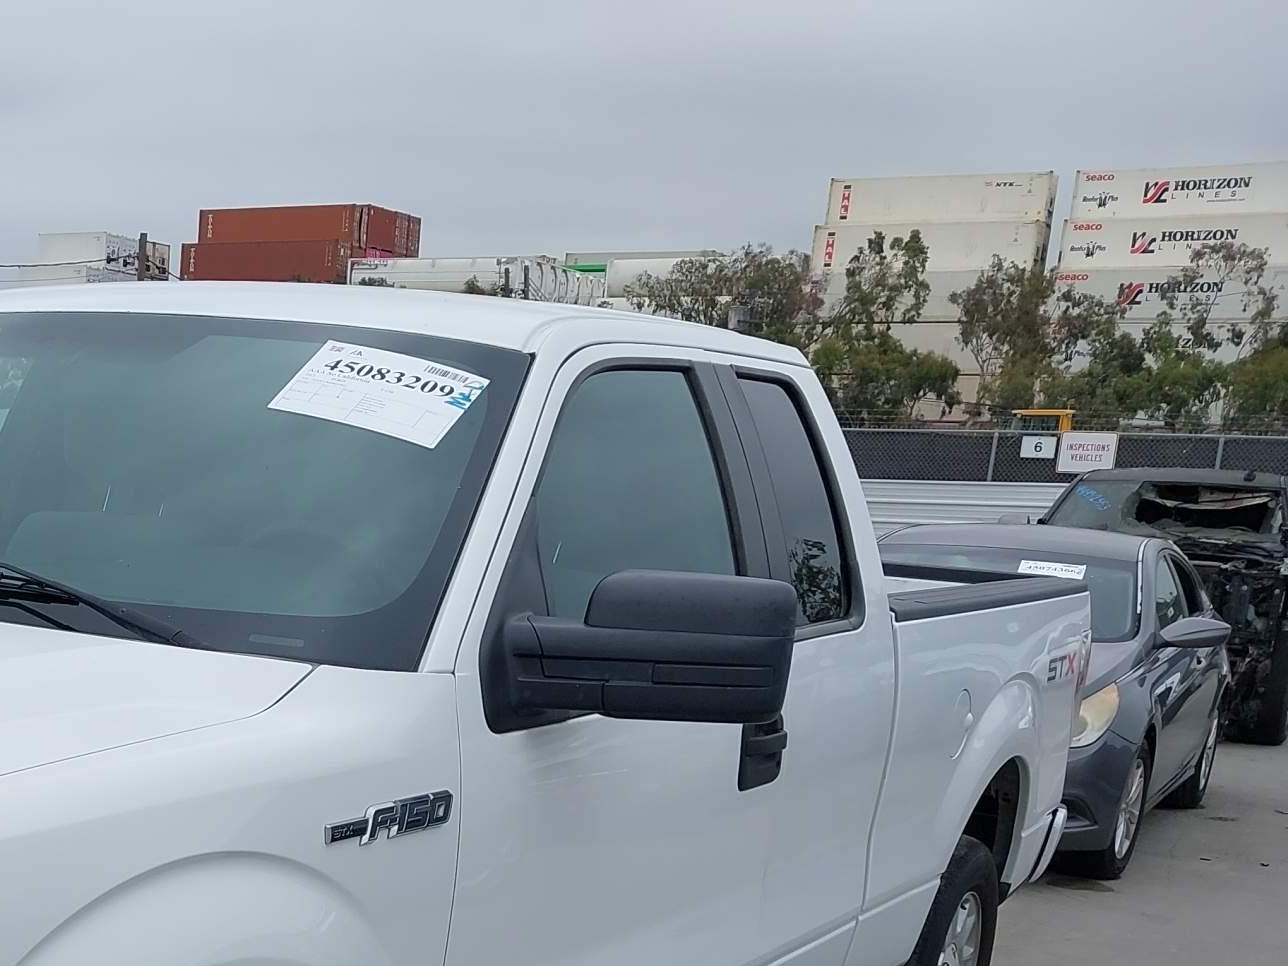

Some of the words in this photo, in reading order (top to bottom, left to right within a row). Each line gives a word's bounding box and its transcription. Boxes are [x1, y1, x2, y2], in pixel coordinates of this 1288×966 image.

[1085, 174, 1115, 182] seaco
[1172, 177, 1253, 192] HORIZON
[1170, 190, 1238, 200] LINES
[1073, 223, 1103, 231] seaco
[1160, 229, 1240, 242] HORIZON
[324, 359, 455, 398] 45083209
[1034, 441, 1043, 453] 6
[1066, 443, 1111, 452] INSPECTIONS
[1070, 453, 1103, 463] VEHICLES
[1047, 655, 1076, 683] STX
